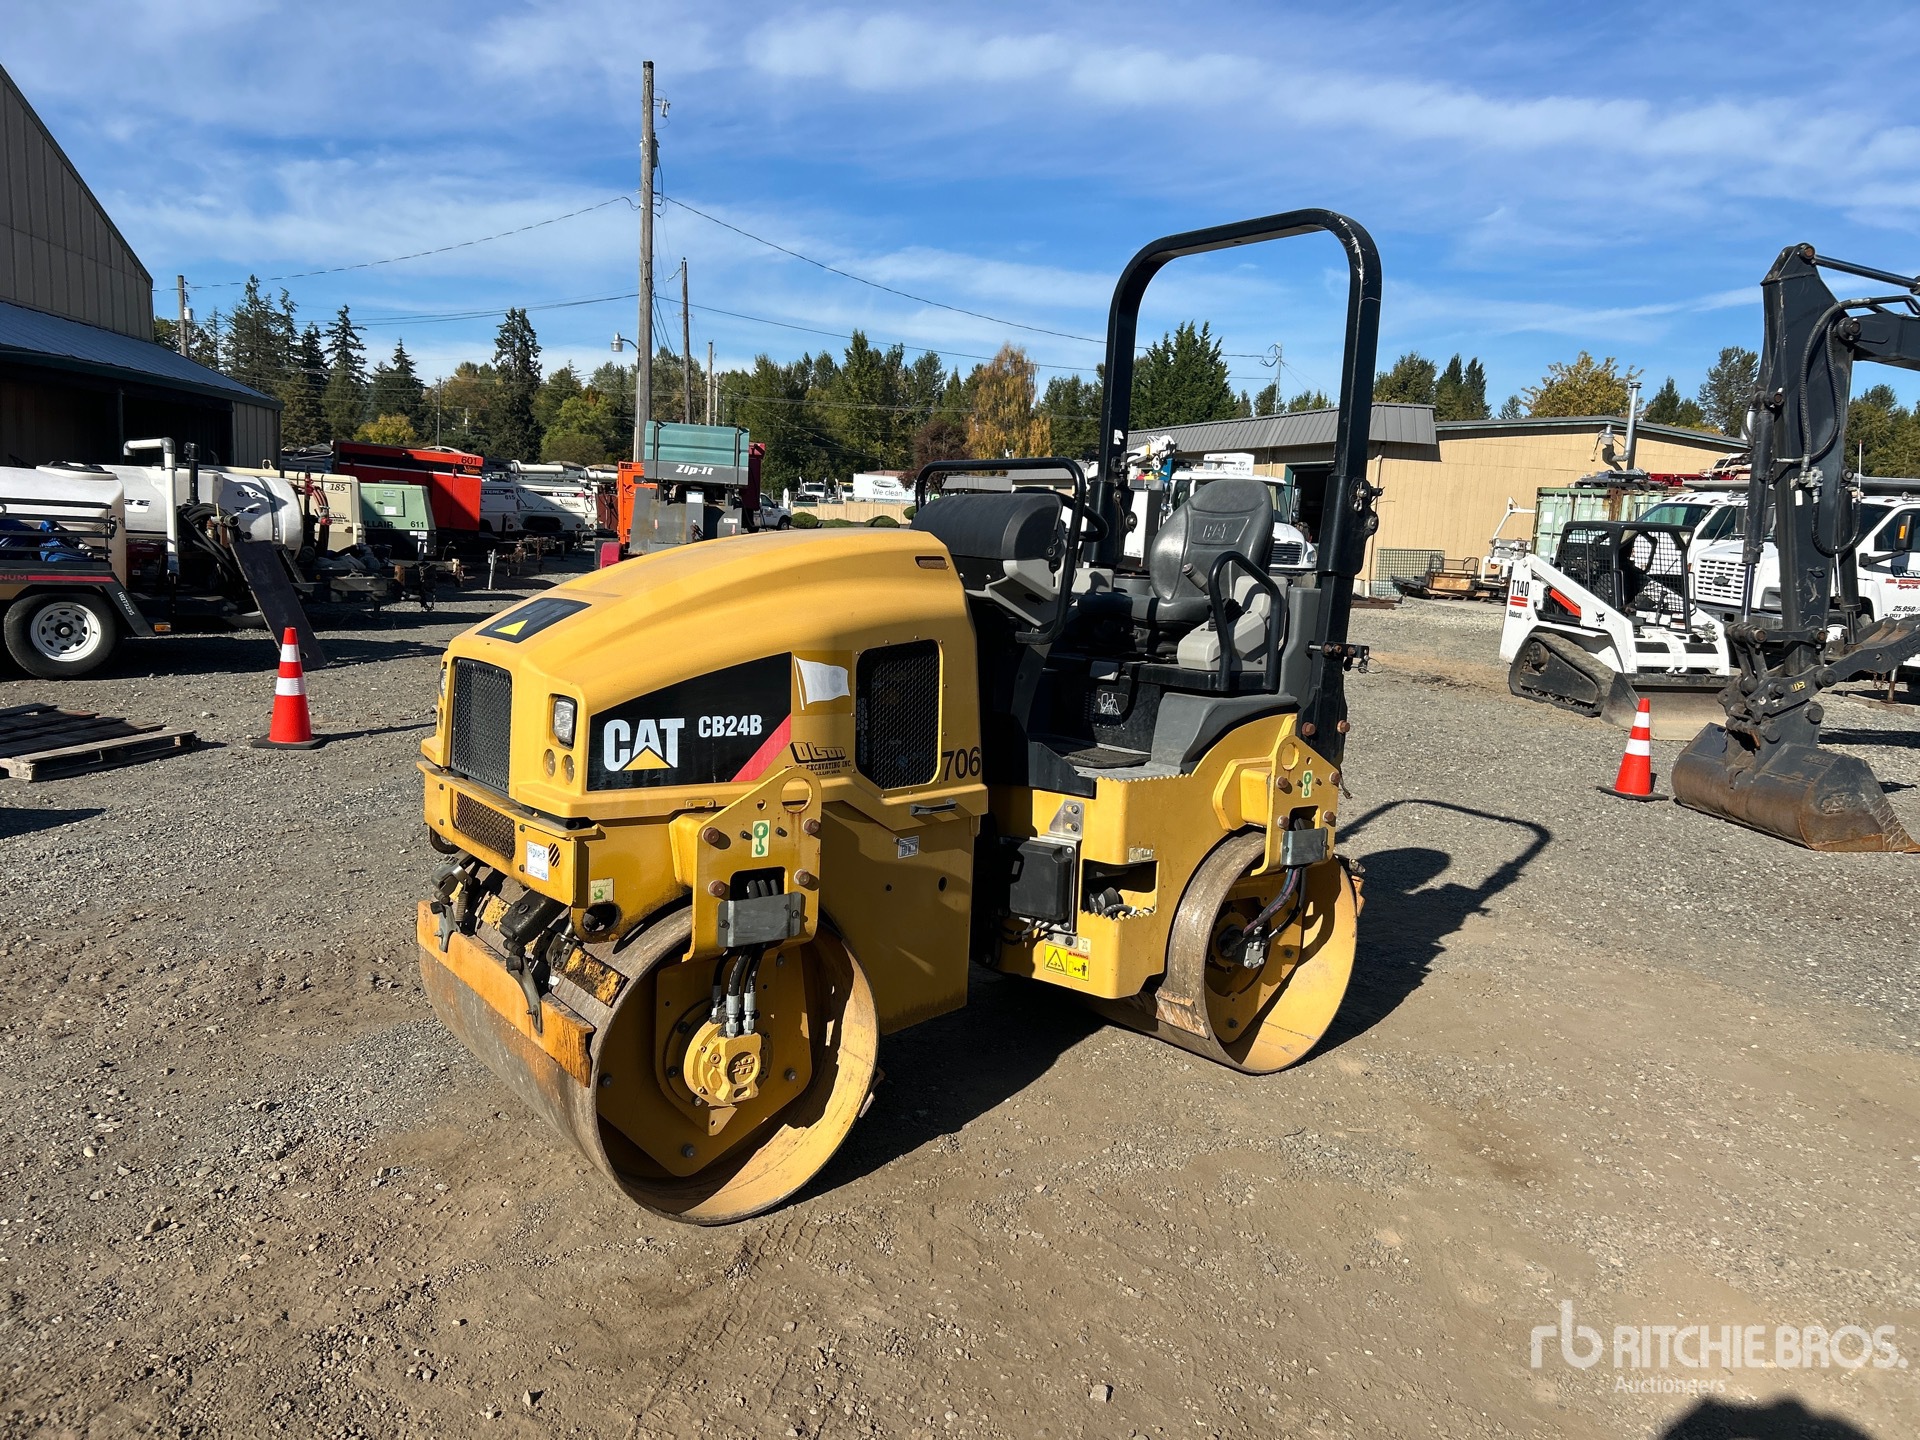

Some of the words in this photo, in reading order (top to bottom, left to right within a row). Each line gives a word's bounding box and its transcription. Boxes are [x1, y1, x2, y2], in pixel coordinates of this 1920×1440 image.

[461, 456, 477, 465] 601
[675, 464, 714, 476] Zip-it
[330, 483, 346, 492] 185
[1511, 580, 1530, 597] T140
[1508, 609, 1523, 619] Bobcat
[698, 714, 763, 738] CB24B
[603, 718, 685, 772] CAT
[942, 746, 981, 781] 706
